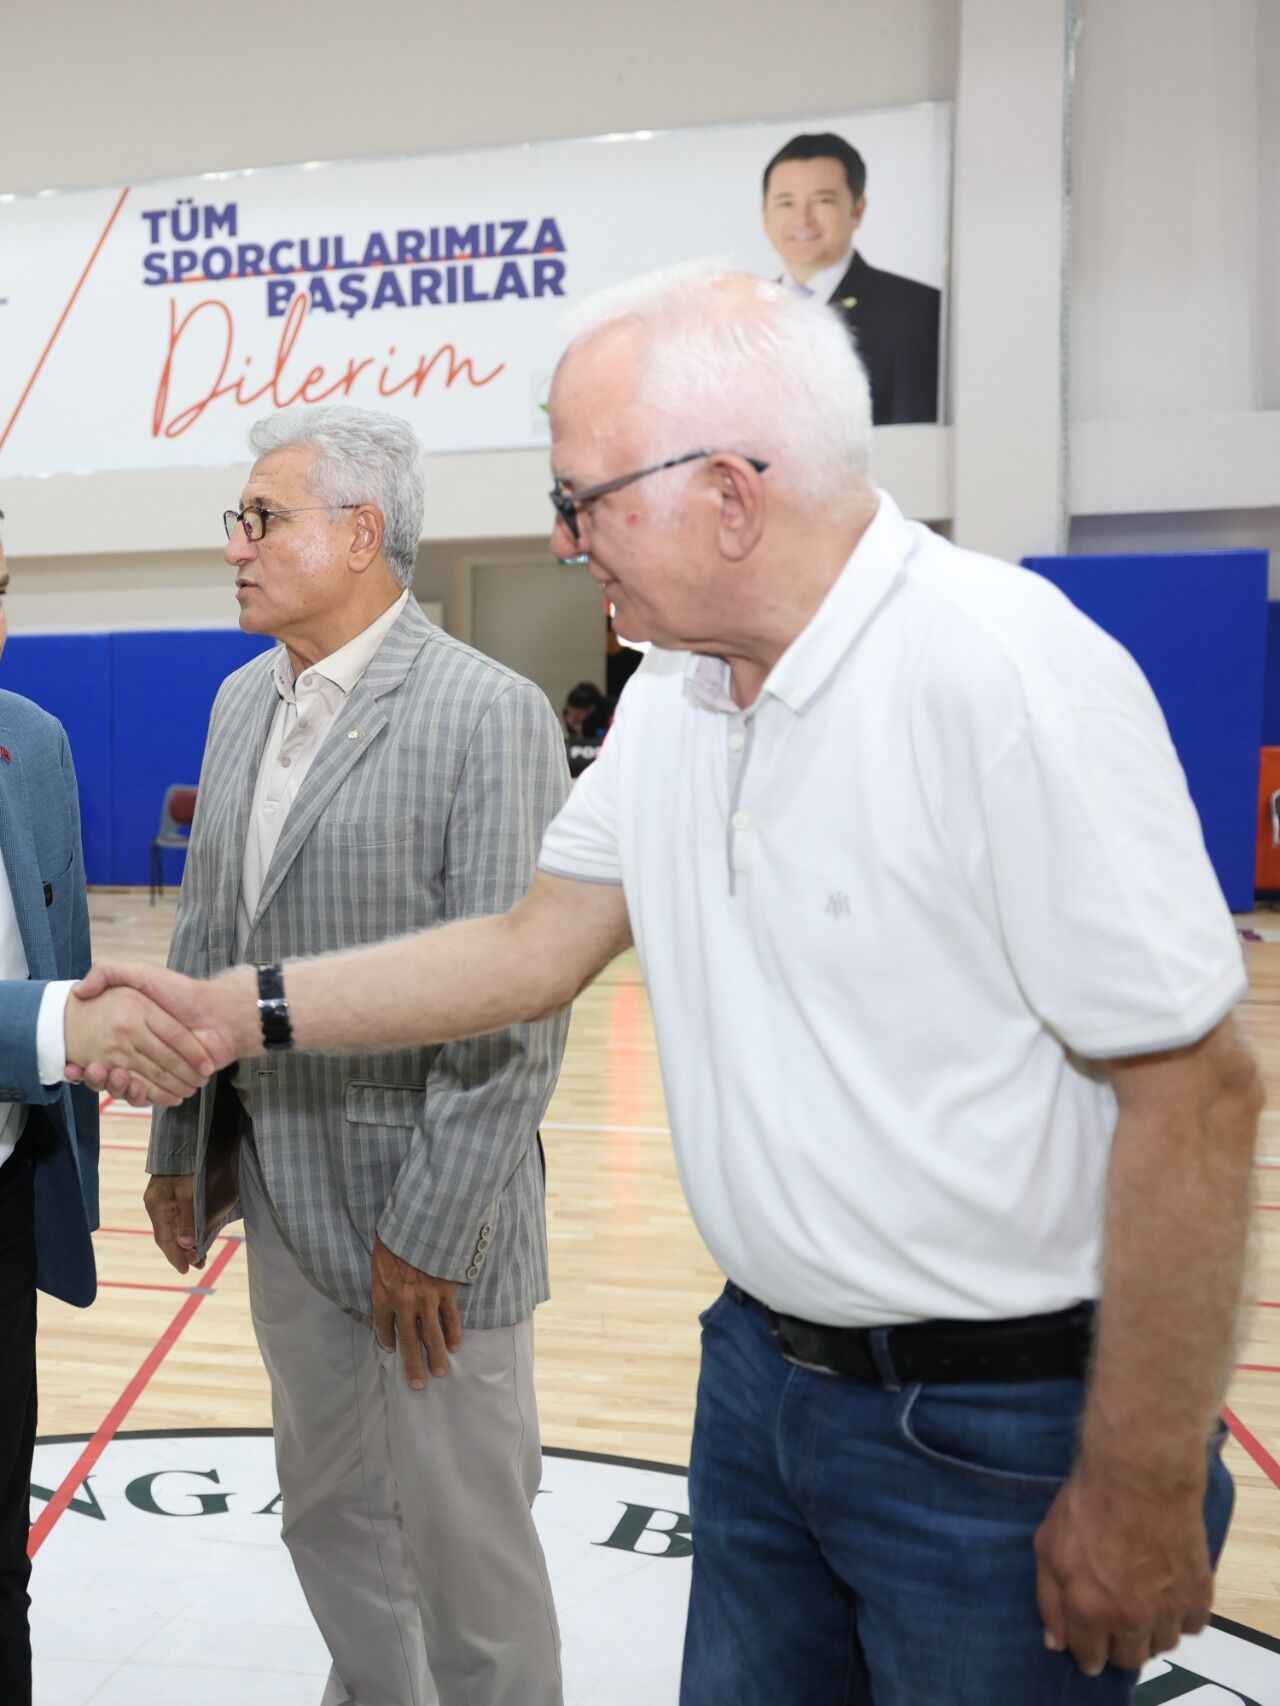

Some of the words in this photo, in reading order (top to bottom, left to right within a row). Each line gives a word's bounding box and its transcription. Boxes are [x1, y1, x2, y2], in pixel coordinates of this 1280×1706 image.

[141, 198, 239, 245] TÜM
[141, 216, 567, 287] SPORCULARIMIZA
[266, 258, 567, 318] BAŞARILAR
[151, 292, 506, 439] Dilerim
